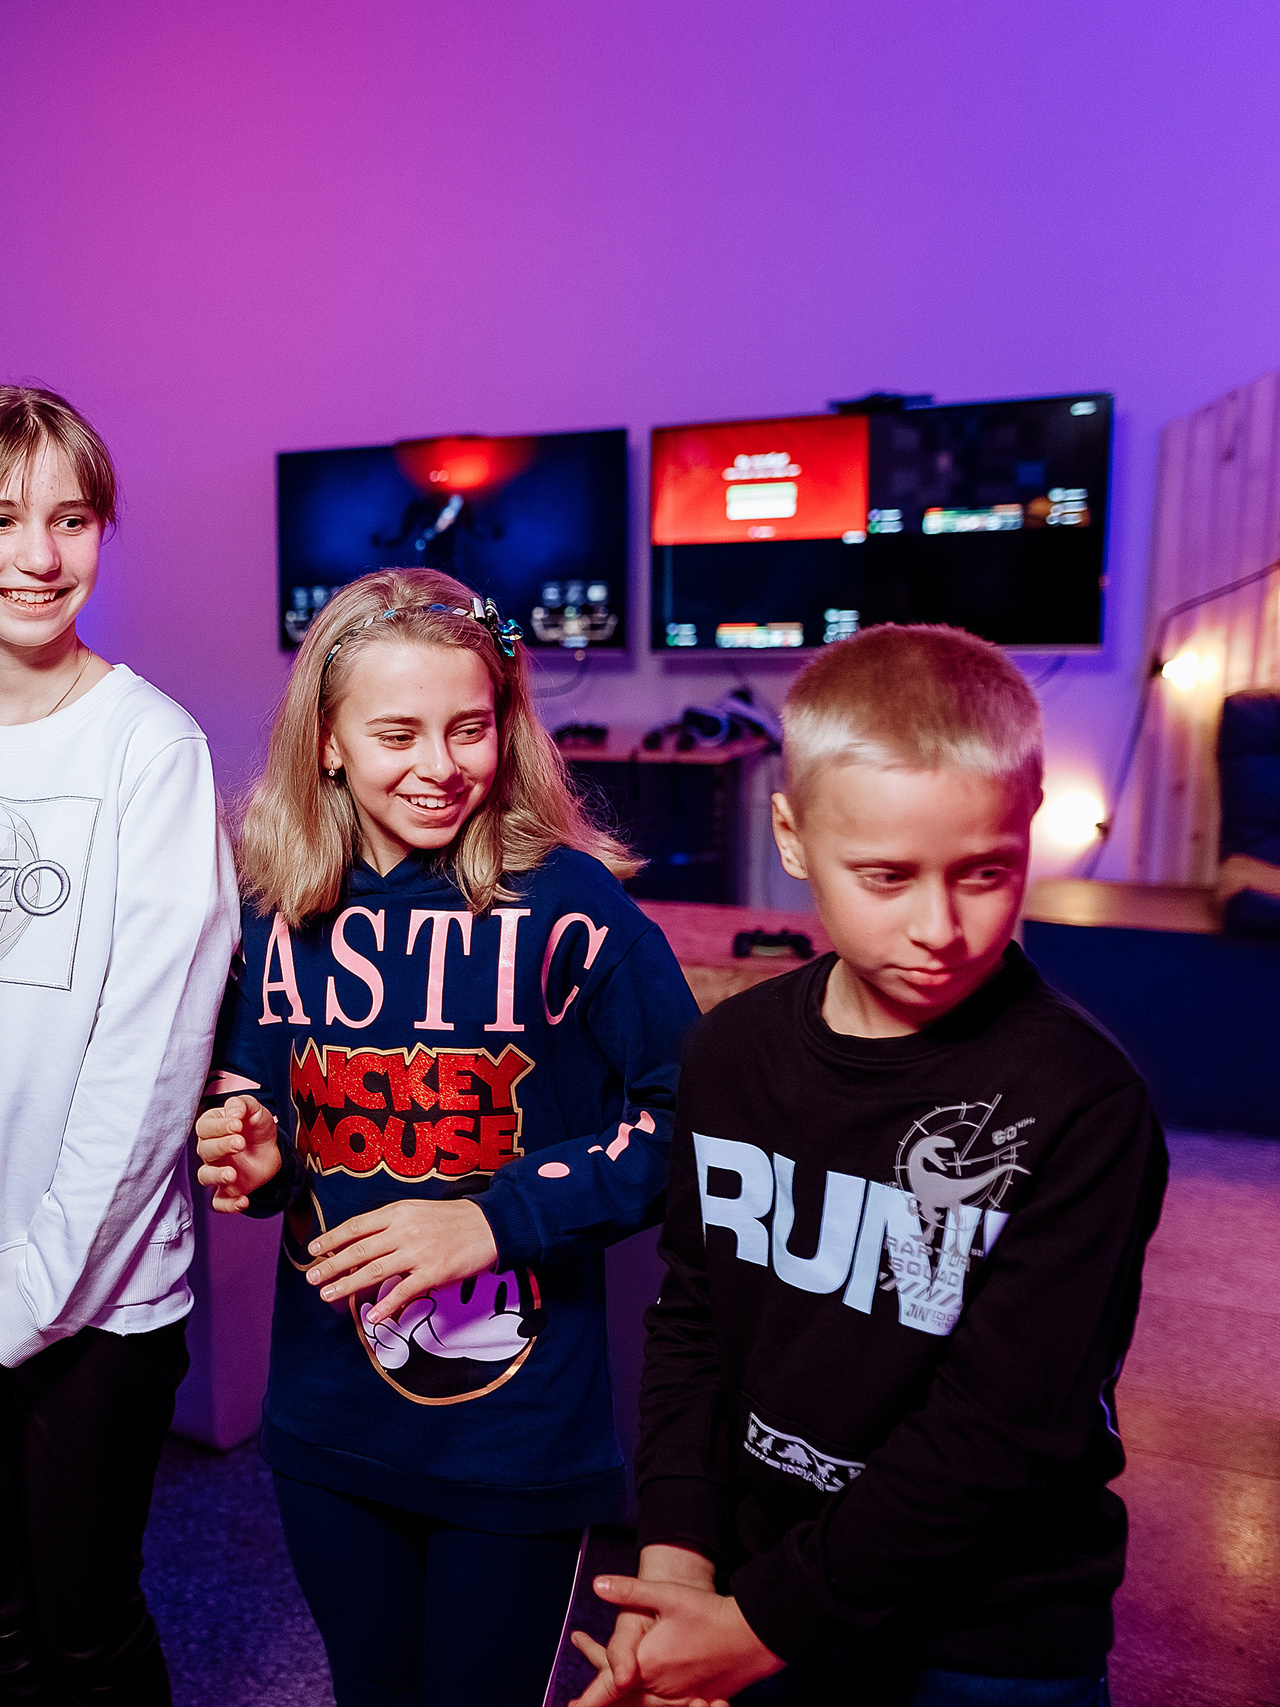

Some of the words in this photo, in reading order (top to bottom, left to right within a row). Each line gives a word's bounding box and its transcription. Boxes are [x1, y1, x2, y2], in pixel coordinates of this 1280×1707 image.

[291, 1046, 529, 1112] MICKEY
[297, 1109, 522, 1177] MOUSE
[692, 1131, 1011, 1336] RUN
